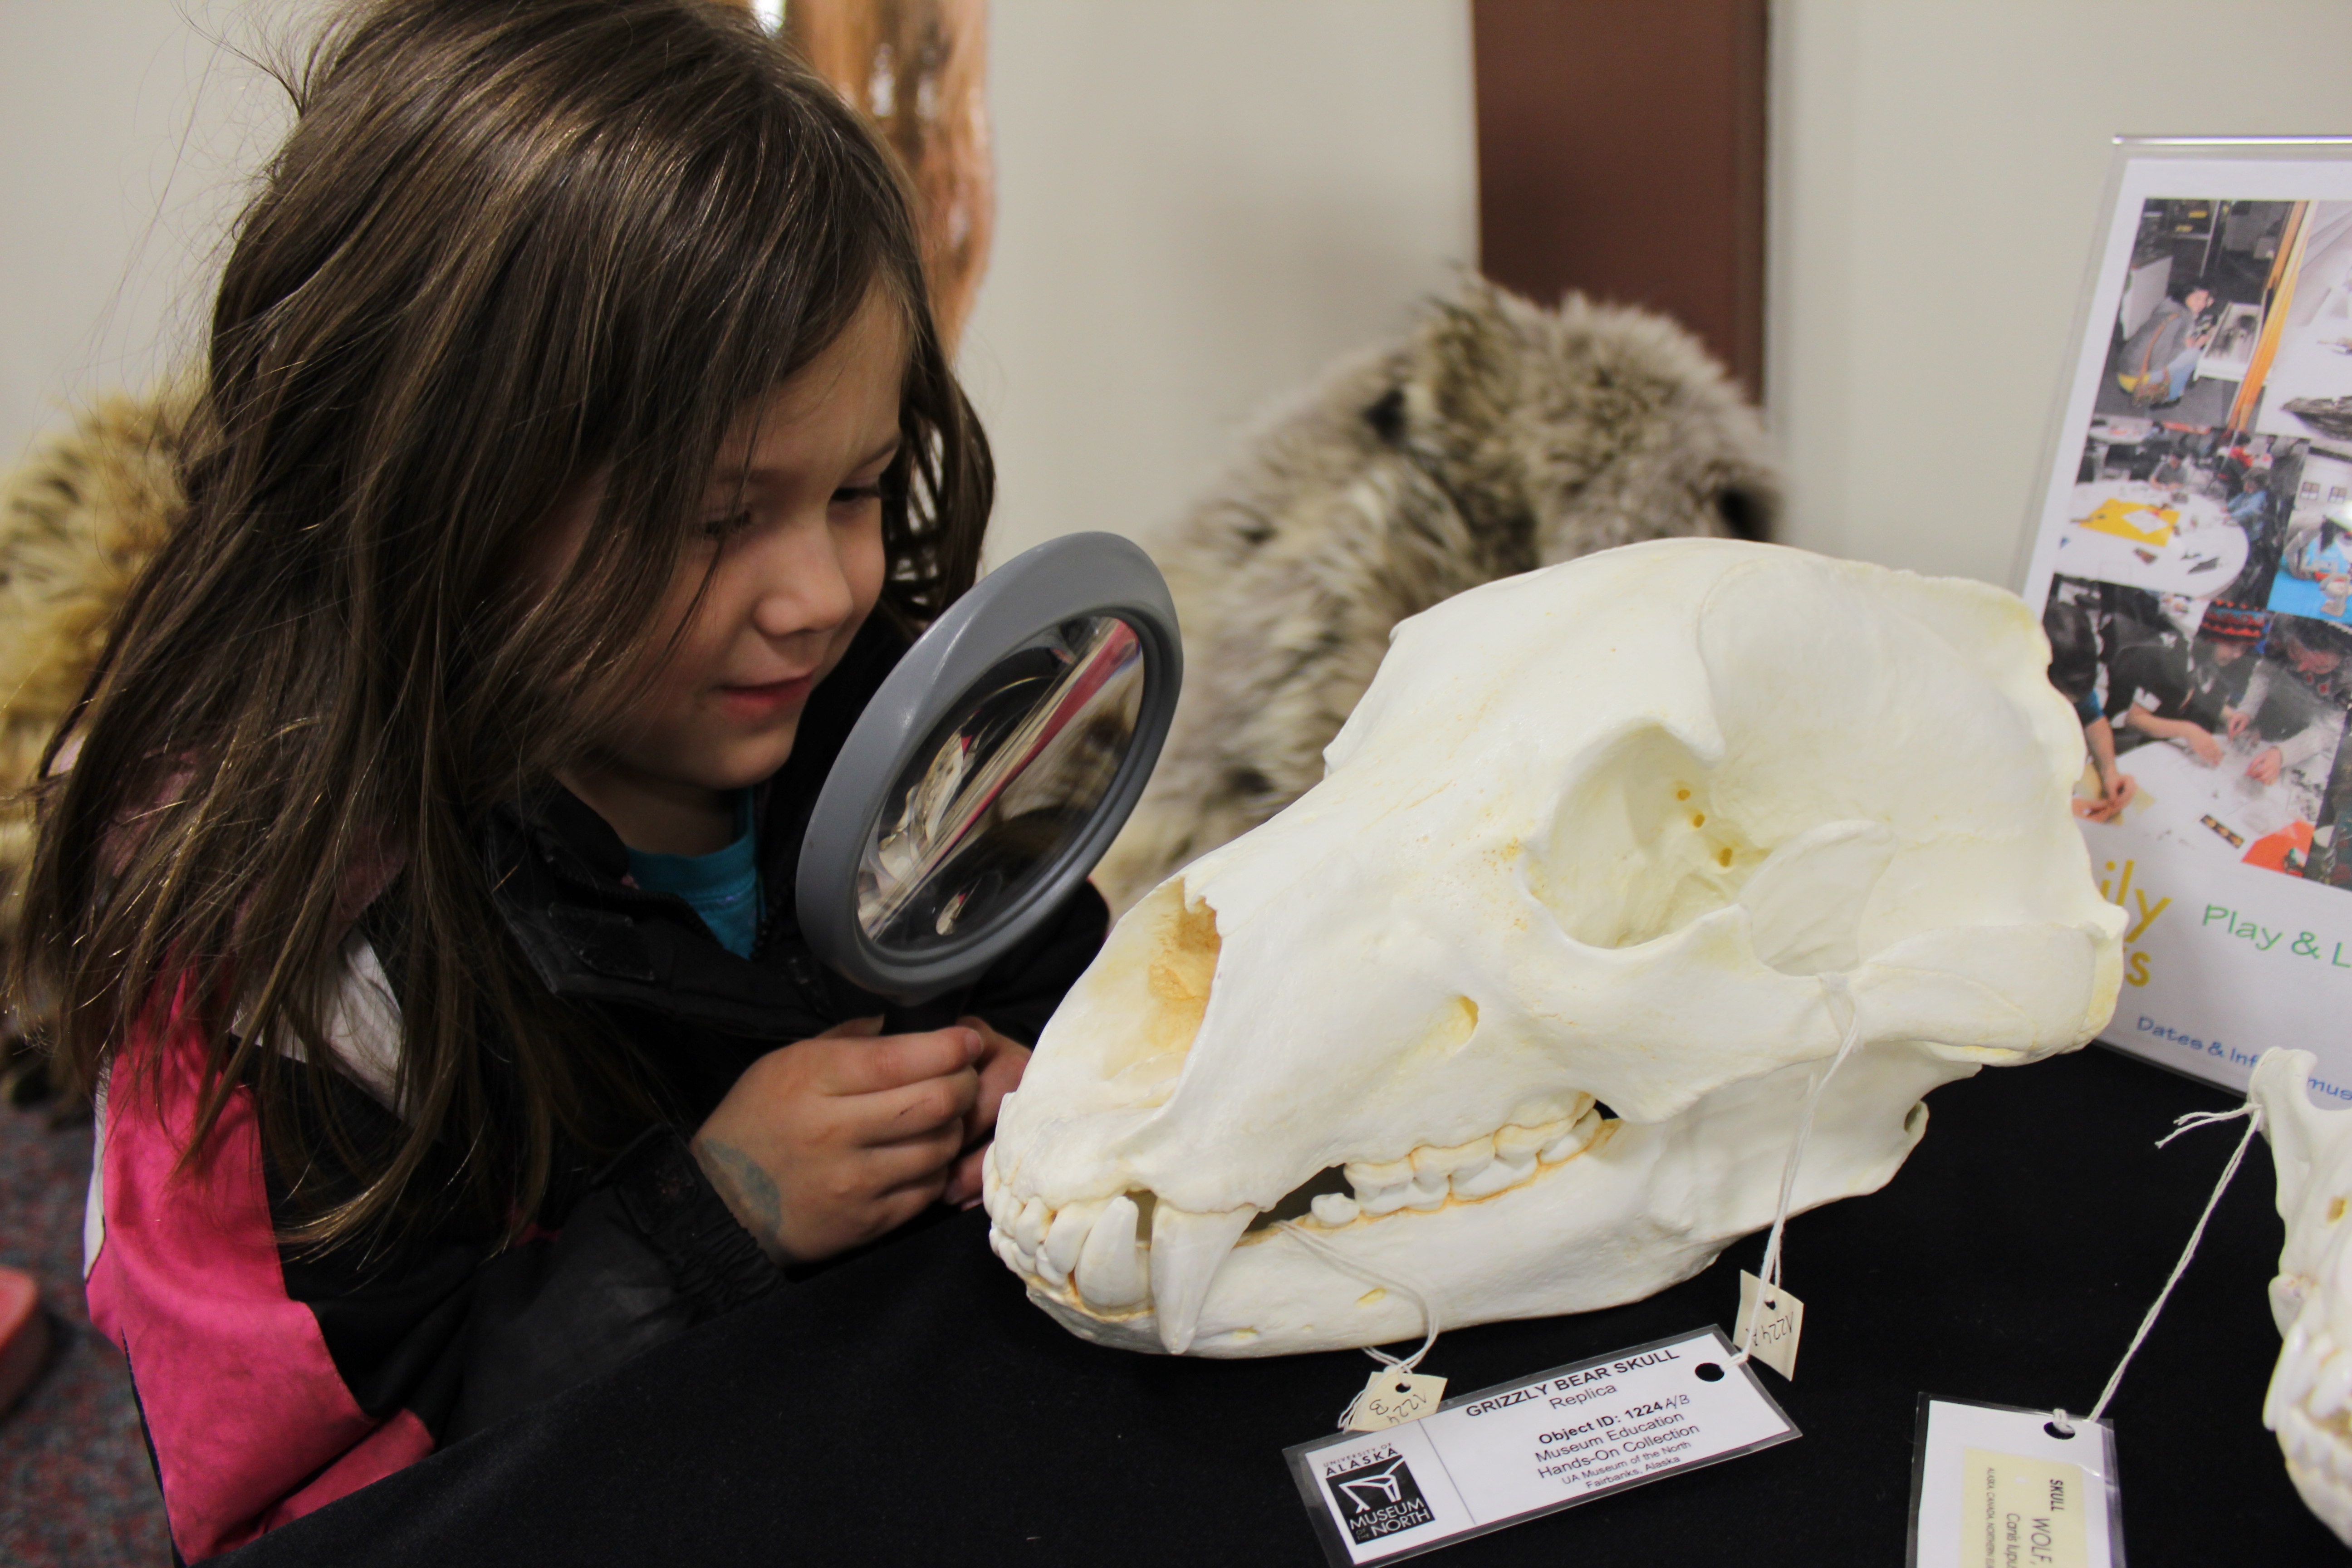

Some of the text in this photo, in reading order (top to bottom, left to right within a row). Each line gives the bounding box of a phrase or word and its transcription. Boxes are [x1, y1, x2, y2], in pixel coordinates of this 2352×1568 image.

[2202, 904, 2283, 951] Play
[2291, 931, 2320, 959] &
[2137, 1016, 2203, 1051] Dates
[2207, 1042, 2225, 1058] &
[1466, 1349, 1680, 1416] GRIZZLY BEAR SKULL
[1548, 1383, 1618, 1410] Replica
[1386, 1392, 1427, 1424] 1224
[1535, 1411, 1685, 1462] Museum Education
[1539, 1422, 1594, 1444] Object
[1596, 1414, 1622, 1429] ID:
[1323, 1447, 1376, 1468] UNIVERSITY
[1326, 1447, 1398, 1476] ALASKA
[1537, 1423, 1700, 1479] Hands-On Collection
[1561, 1440, 1692, 1485] UA Museum of the North
[1585, 1455, 1681, 1490] Fairbanks, Alaska
[2049, 1479, 2064, 1512] SKULL
[1349, 1497, 1425, 1530] MUSEUM
[1370, 1508, 1431, 1537] NORTH
[2006, 1513, 2021, 1543] Canis
[2030, 1518, 2052, 1565] WOLF,
